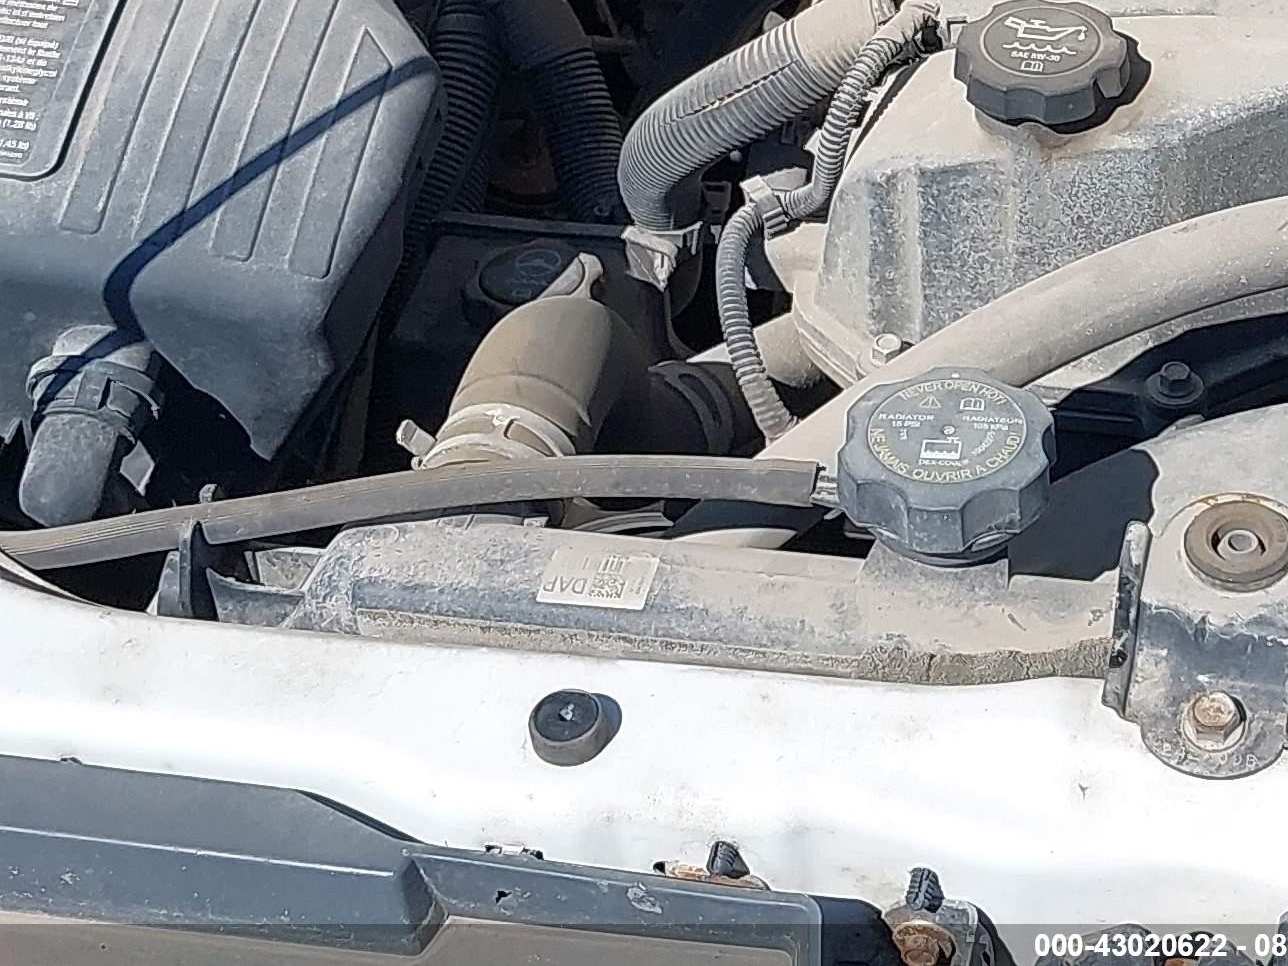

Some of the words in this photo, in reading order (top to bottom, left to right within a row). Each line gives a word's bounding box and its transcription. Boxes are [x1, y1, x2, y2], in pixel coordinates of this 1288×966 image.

[1011, 51, 1029, 59] SAE
[899, 380, 943, 401] NEVER
[944, 380, 980, 394] OPEN
[878, 413, 935, 421] RADIATOR
[962, 415, 1023, 424] RADIATEUR
[912, 468, 974, 481] OUVRIR
[543, 575, 588, 595] DAP
